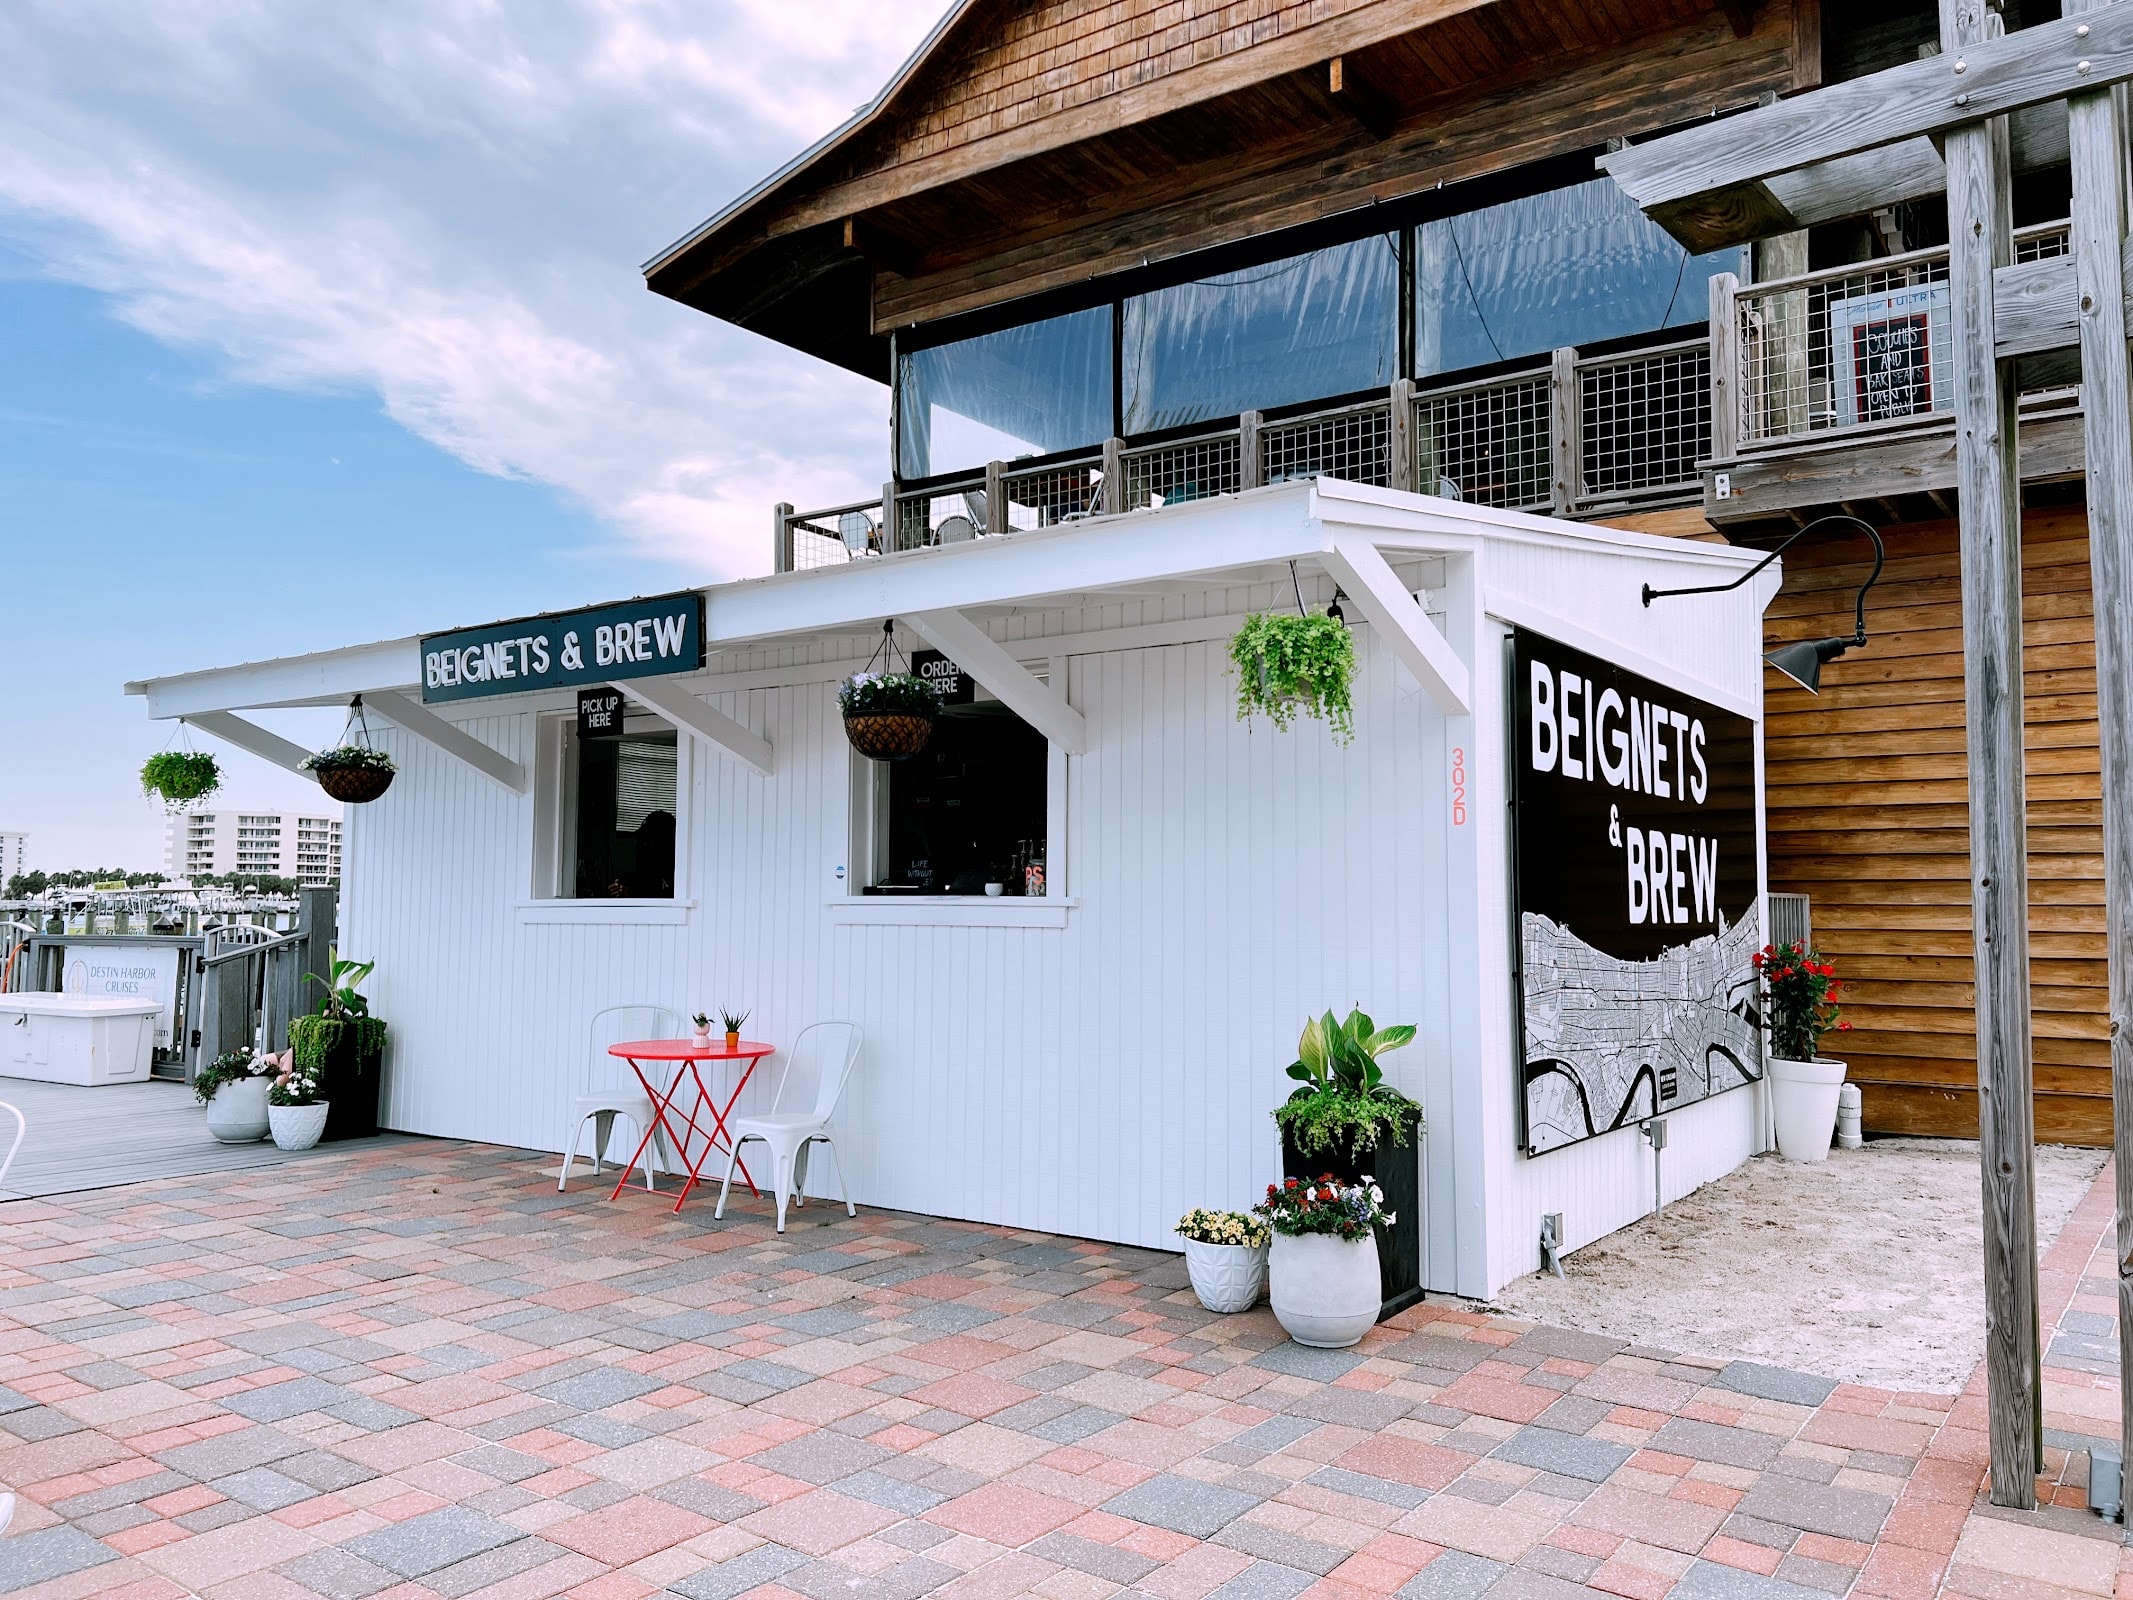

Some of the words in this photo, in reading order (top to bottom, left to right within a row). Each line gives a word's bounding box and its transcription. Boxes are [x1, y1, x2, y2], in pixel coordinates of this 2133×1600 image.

[1896, 291, 1936, 306] ULTRA
[1880, 352, 1901, 371] AND
[1870, 388, 1899, 405] OPEN
[425, 635, 550, 689] BEIGNETS
[560, 630, 585, 671] &
[595, 613, 687, 666] BREW
[932, 676, 958, 695] ERE
[581, 697, 603, 714] PICK
[606, 696, 618, 711] UP
[588, 712, 612, 729] HERE
[1531, 659, 1708, 805] BEIGNETS
[1608, 803, 1623, 848] &
[911, 860, 929, 869] LIFE
[907, 869, 934, 878] WITHOUT
[1627, 826, 1717, 924] BREW
[90, 966, 118, 978] DESTIN
[120, 967, 156, 980] HARBOR
[105, 981, 139, 993] CRUISES
